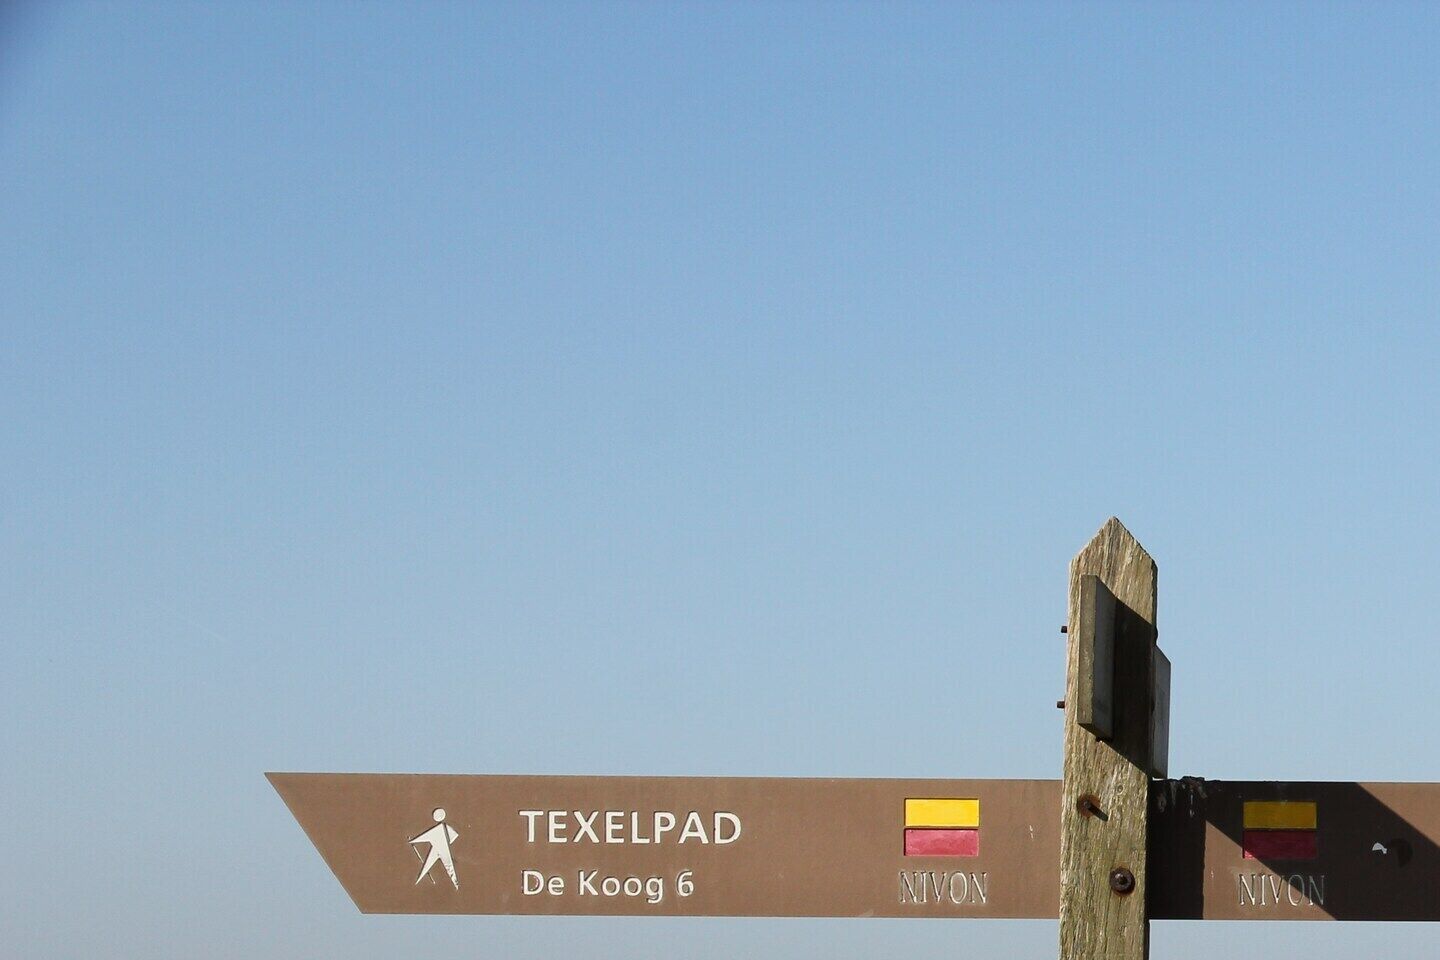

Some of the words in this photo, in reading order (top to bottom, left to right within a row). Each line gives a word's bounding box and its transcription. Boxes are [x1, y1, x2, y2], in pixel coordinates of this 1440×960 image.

[519, 810, 742, 845] TEXELPAD
[521, 870, 565, 896] De
[577, 869, 665, 904] Koog
[676, 870, 695, 898] 6
[899, 870, 988, 904] NIVON
[1237, 873, 1326, 907] NIVON
